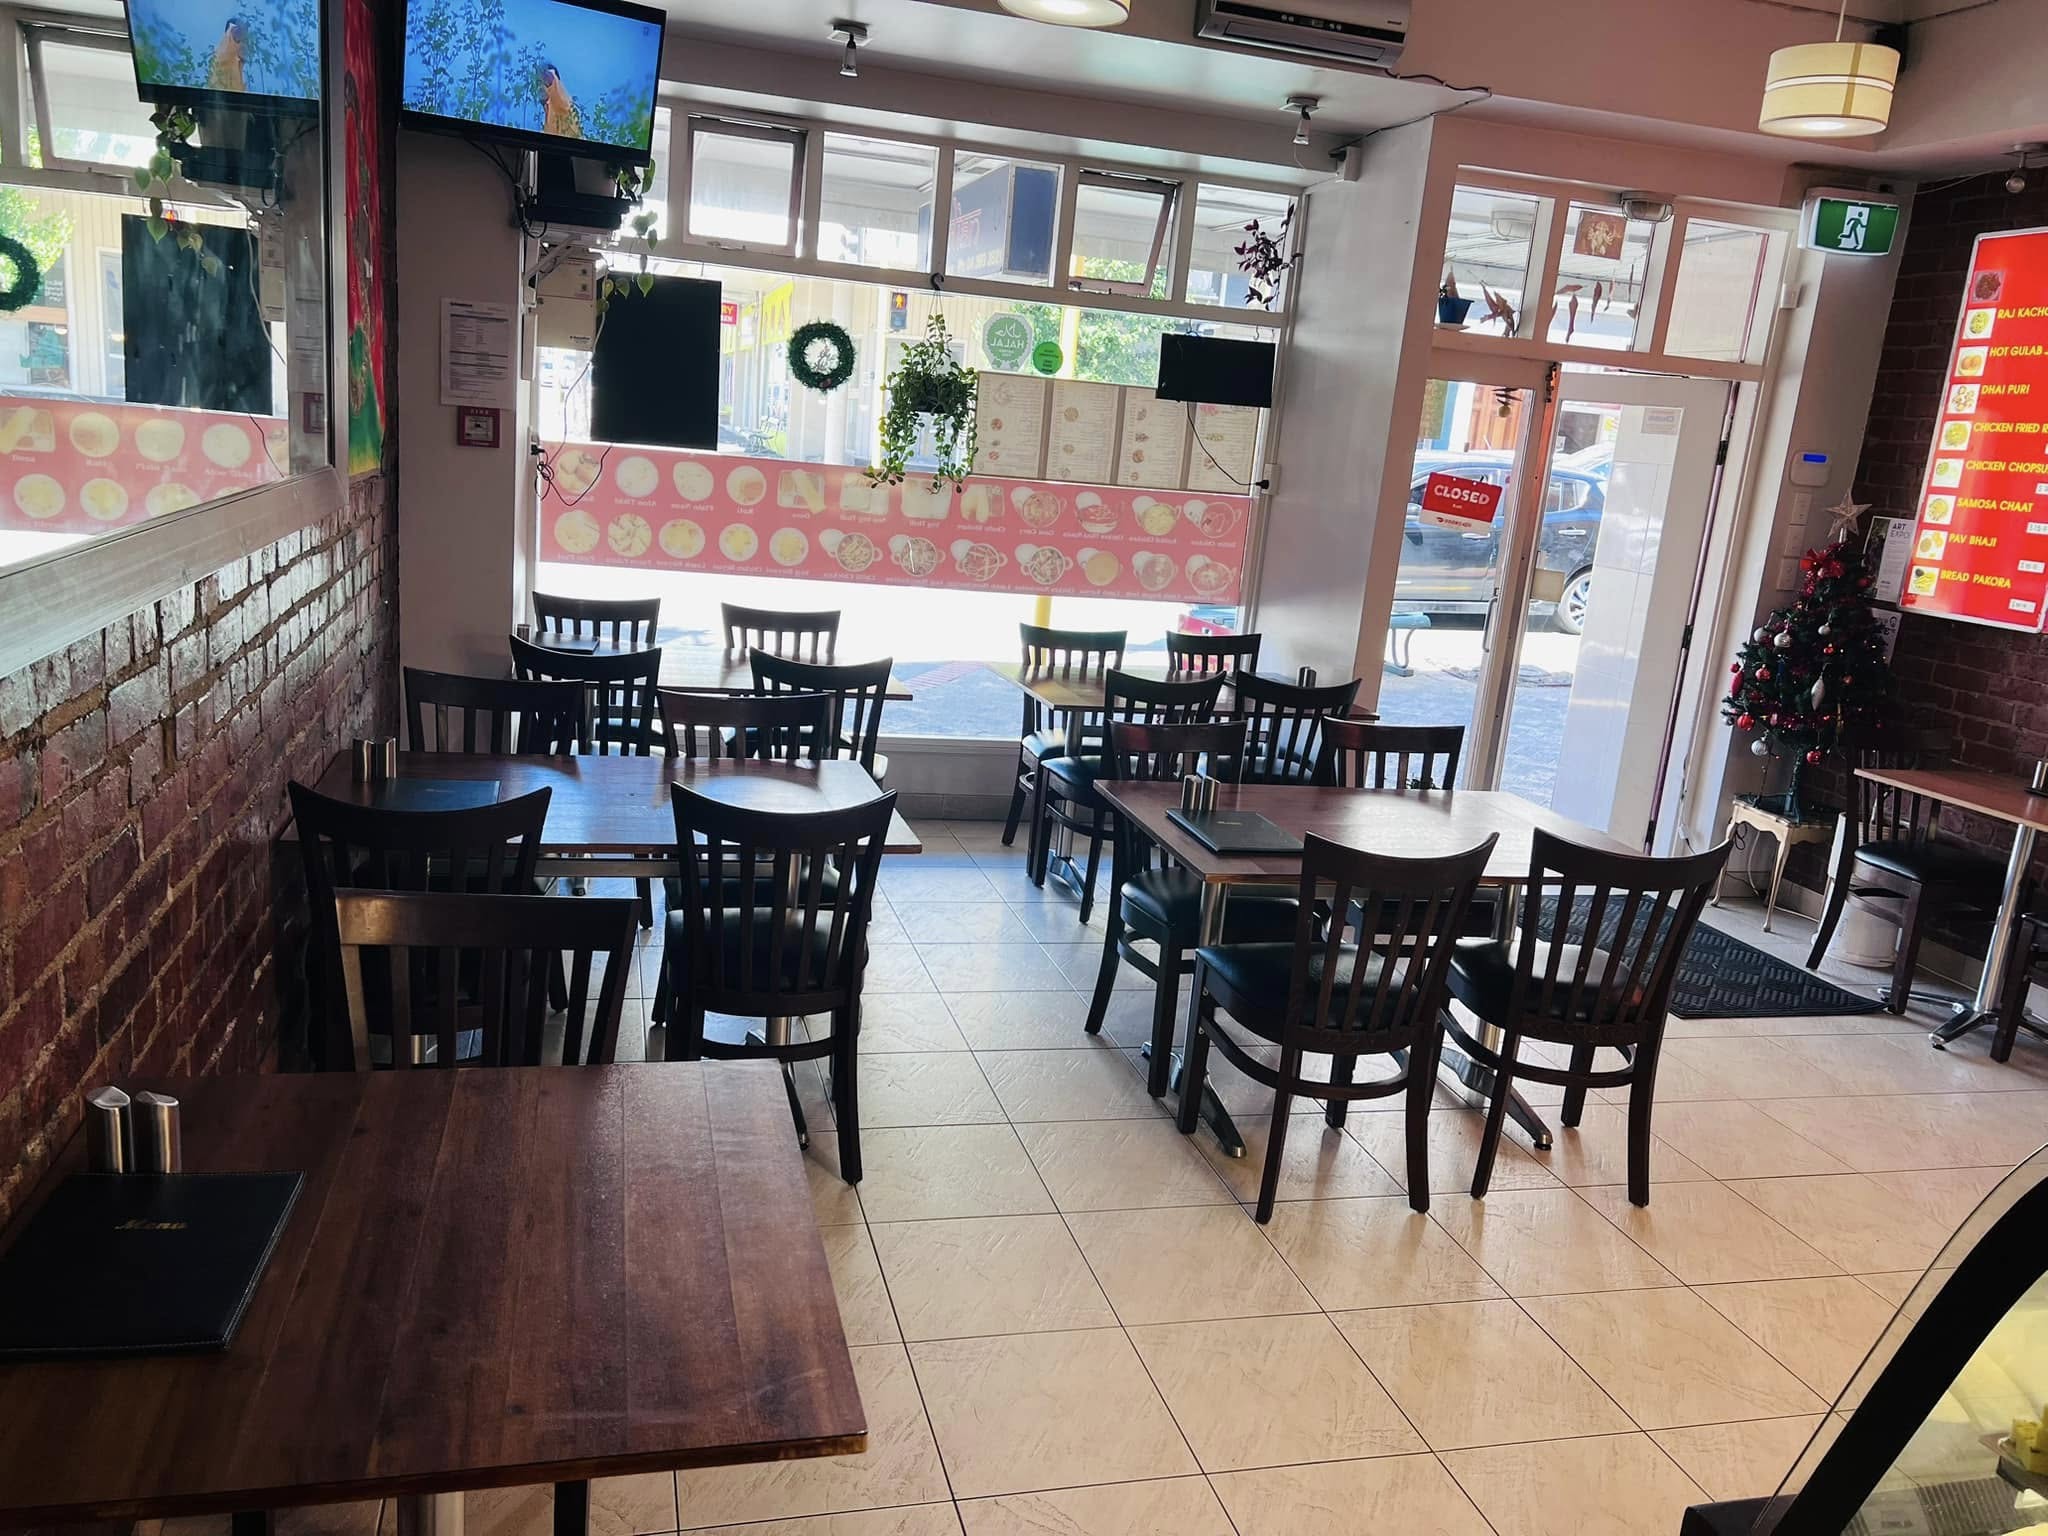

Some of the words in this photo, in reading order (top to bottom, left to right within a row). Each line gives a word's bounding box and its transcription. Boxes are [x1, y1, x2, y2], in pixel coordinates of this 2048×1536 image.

[1997, 308, 2016, 319] RAJ
[1989, 346, 2009, 357] HOT
[2010, 345, 2043, 356] GULAB
[1981, 384, 2006, 395] DHAI
[2007, 384, 2030, 394] PURI
[1973, 422, 2014, 433] CHICKEN
[2015, 422, 2040, 433] FRIED
[1965, 460, 2006, 471] CHICKEN
[1434, 484, 1490, 505] CLOSED
[1957, 498, 1997, 509] SAMOSA
[1999, 500, 2034, 512] CHAAT
[1949, 533, 1968, 544] PAV
[1969, 535, 1998, 547] BHAJI
[1940, 569, 1969, 581] BREAD
[1973, 574, 2011, 588] PAKORA
